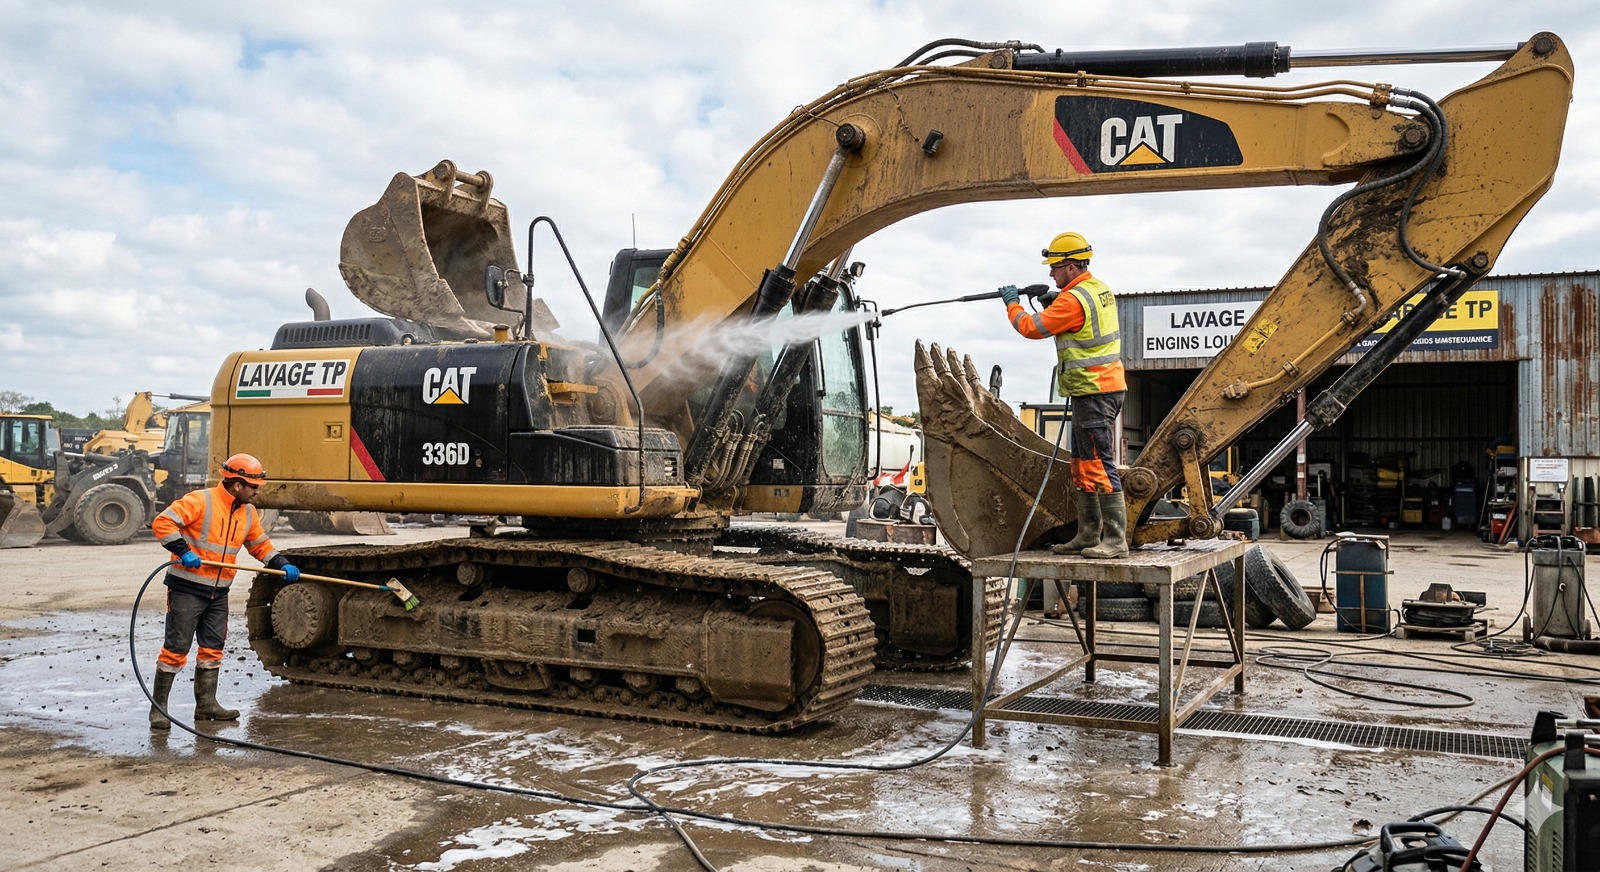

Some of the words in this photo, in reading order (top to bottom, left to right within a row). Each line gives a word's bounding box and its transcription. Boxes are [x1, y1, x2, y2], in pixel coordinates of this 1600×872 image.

[1100, 114, 1183, 166] CAT
[1171, 310, 1245, 329] LAVAGE
[1465, 300, 1493, 319] TP
[1146, 336, 1200, 351] ENGINS
[1204, 335, 1237, 349] LOU
[238, 362, 316, 387] LAVAGE
[322, 361, 346, 385] TP
[422, 366, 478, 405] CAT
[422, 442, 470, 466] 336D
